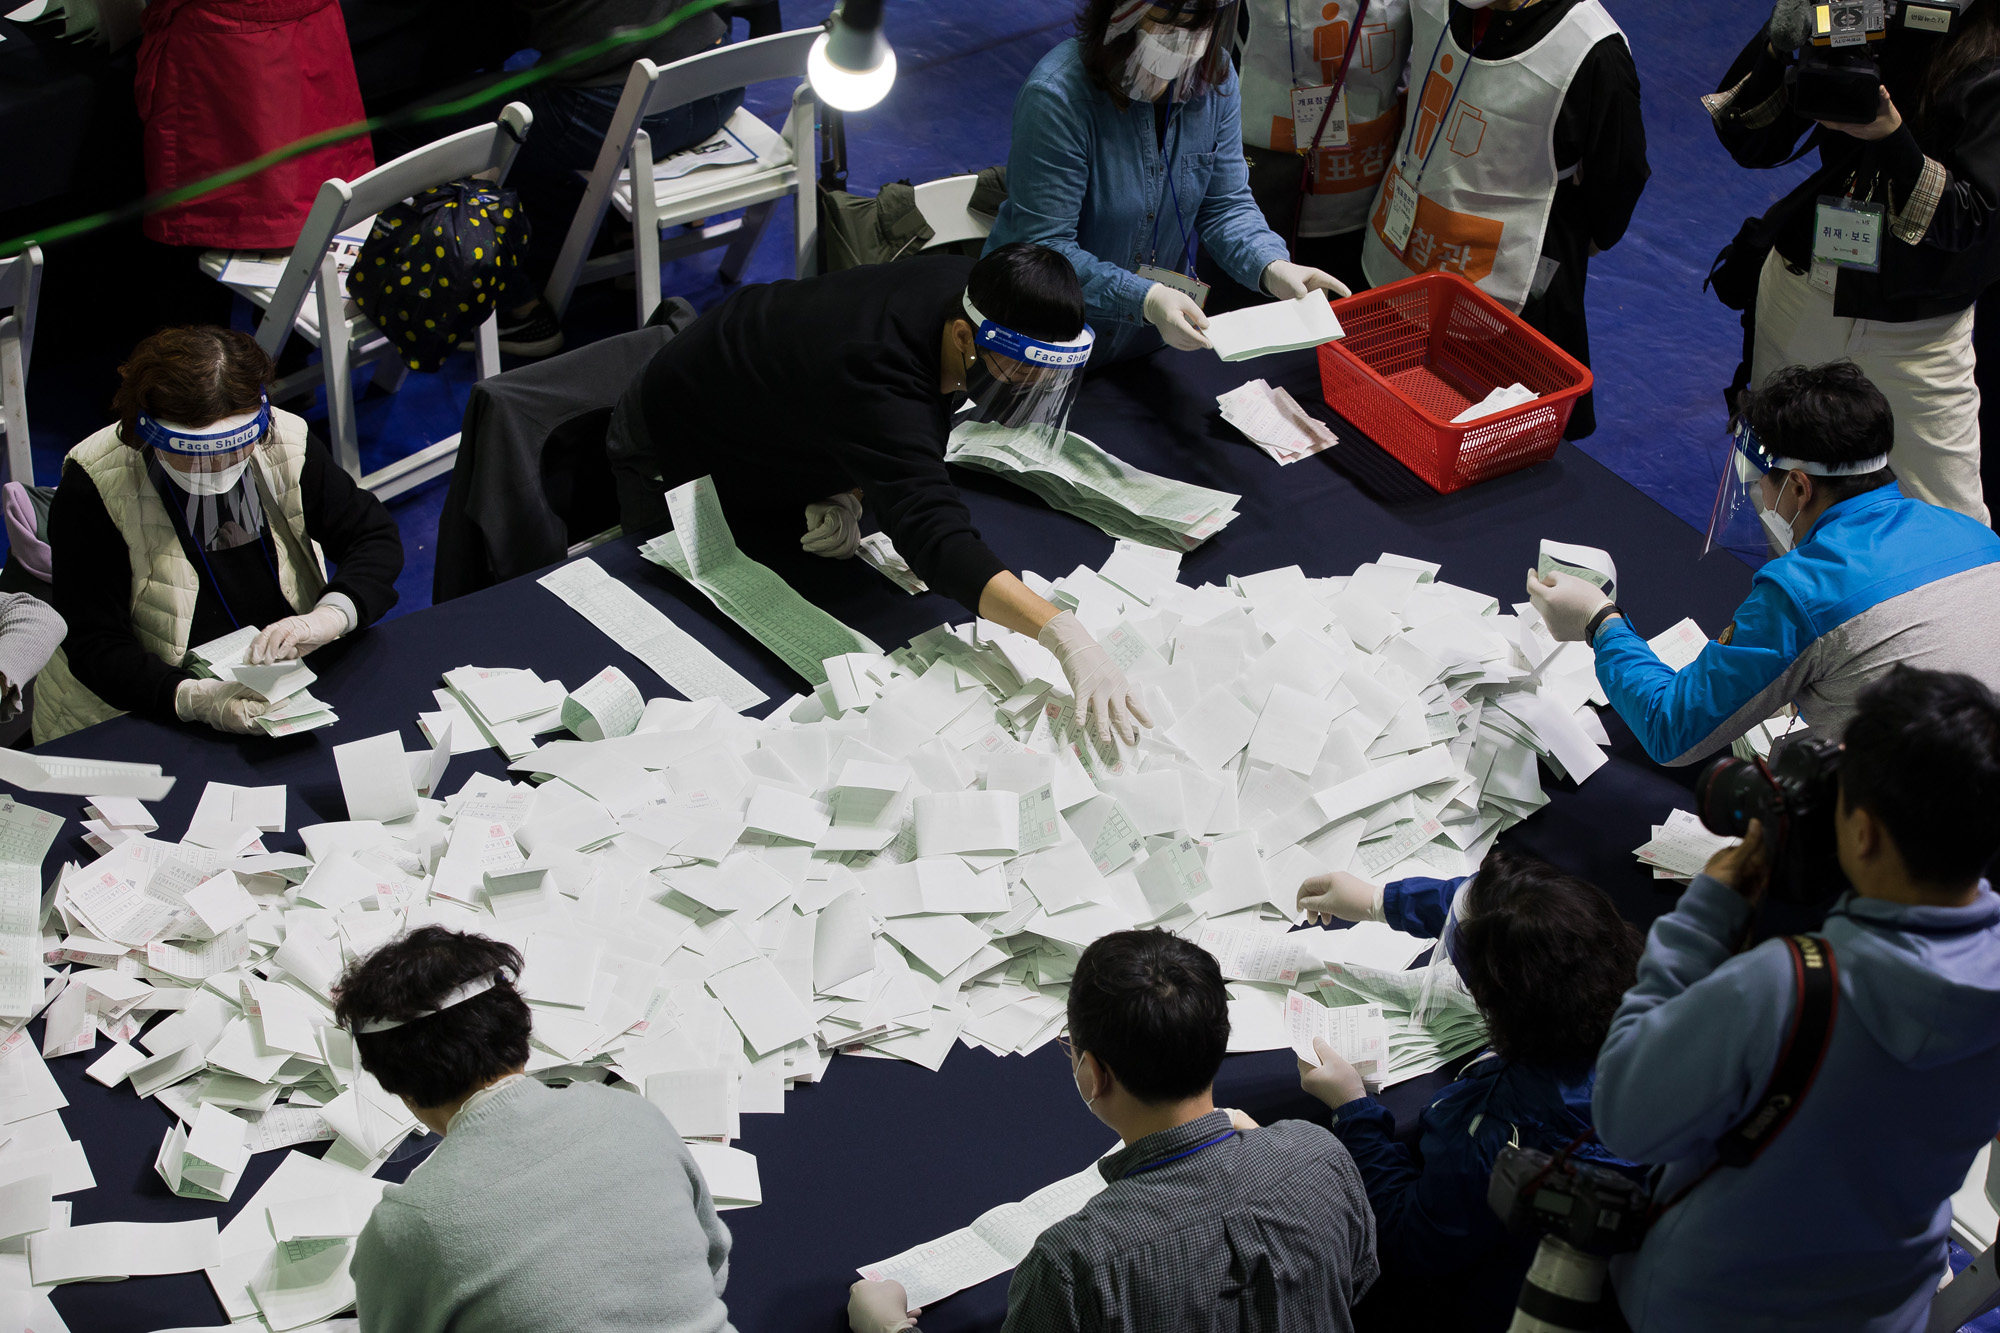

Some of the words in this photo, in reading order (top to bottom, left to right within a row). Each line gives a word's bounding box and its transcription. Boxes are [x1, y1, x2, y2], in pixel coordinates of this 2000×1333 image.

[1314, 143, 1385, 184] 표참
[1034, 350, 1062, 363] Face
[1067, 352, 1088, 363] Shiel
[178, 440, 210, 450] Face
[215, 429, 254, 449] Shield
